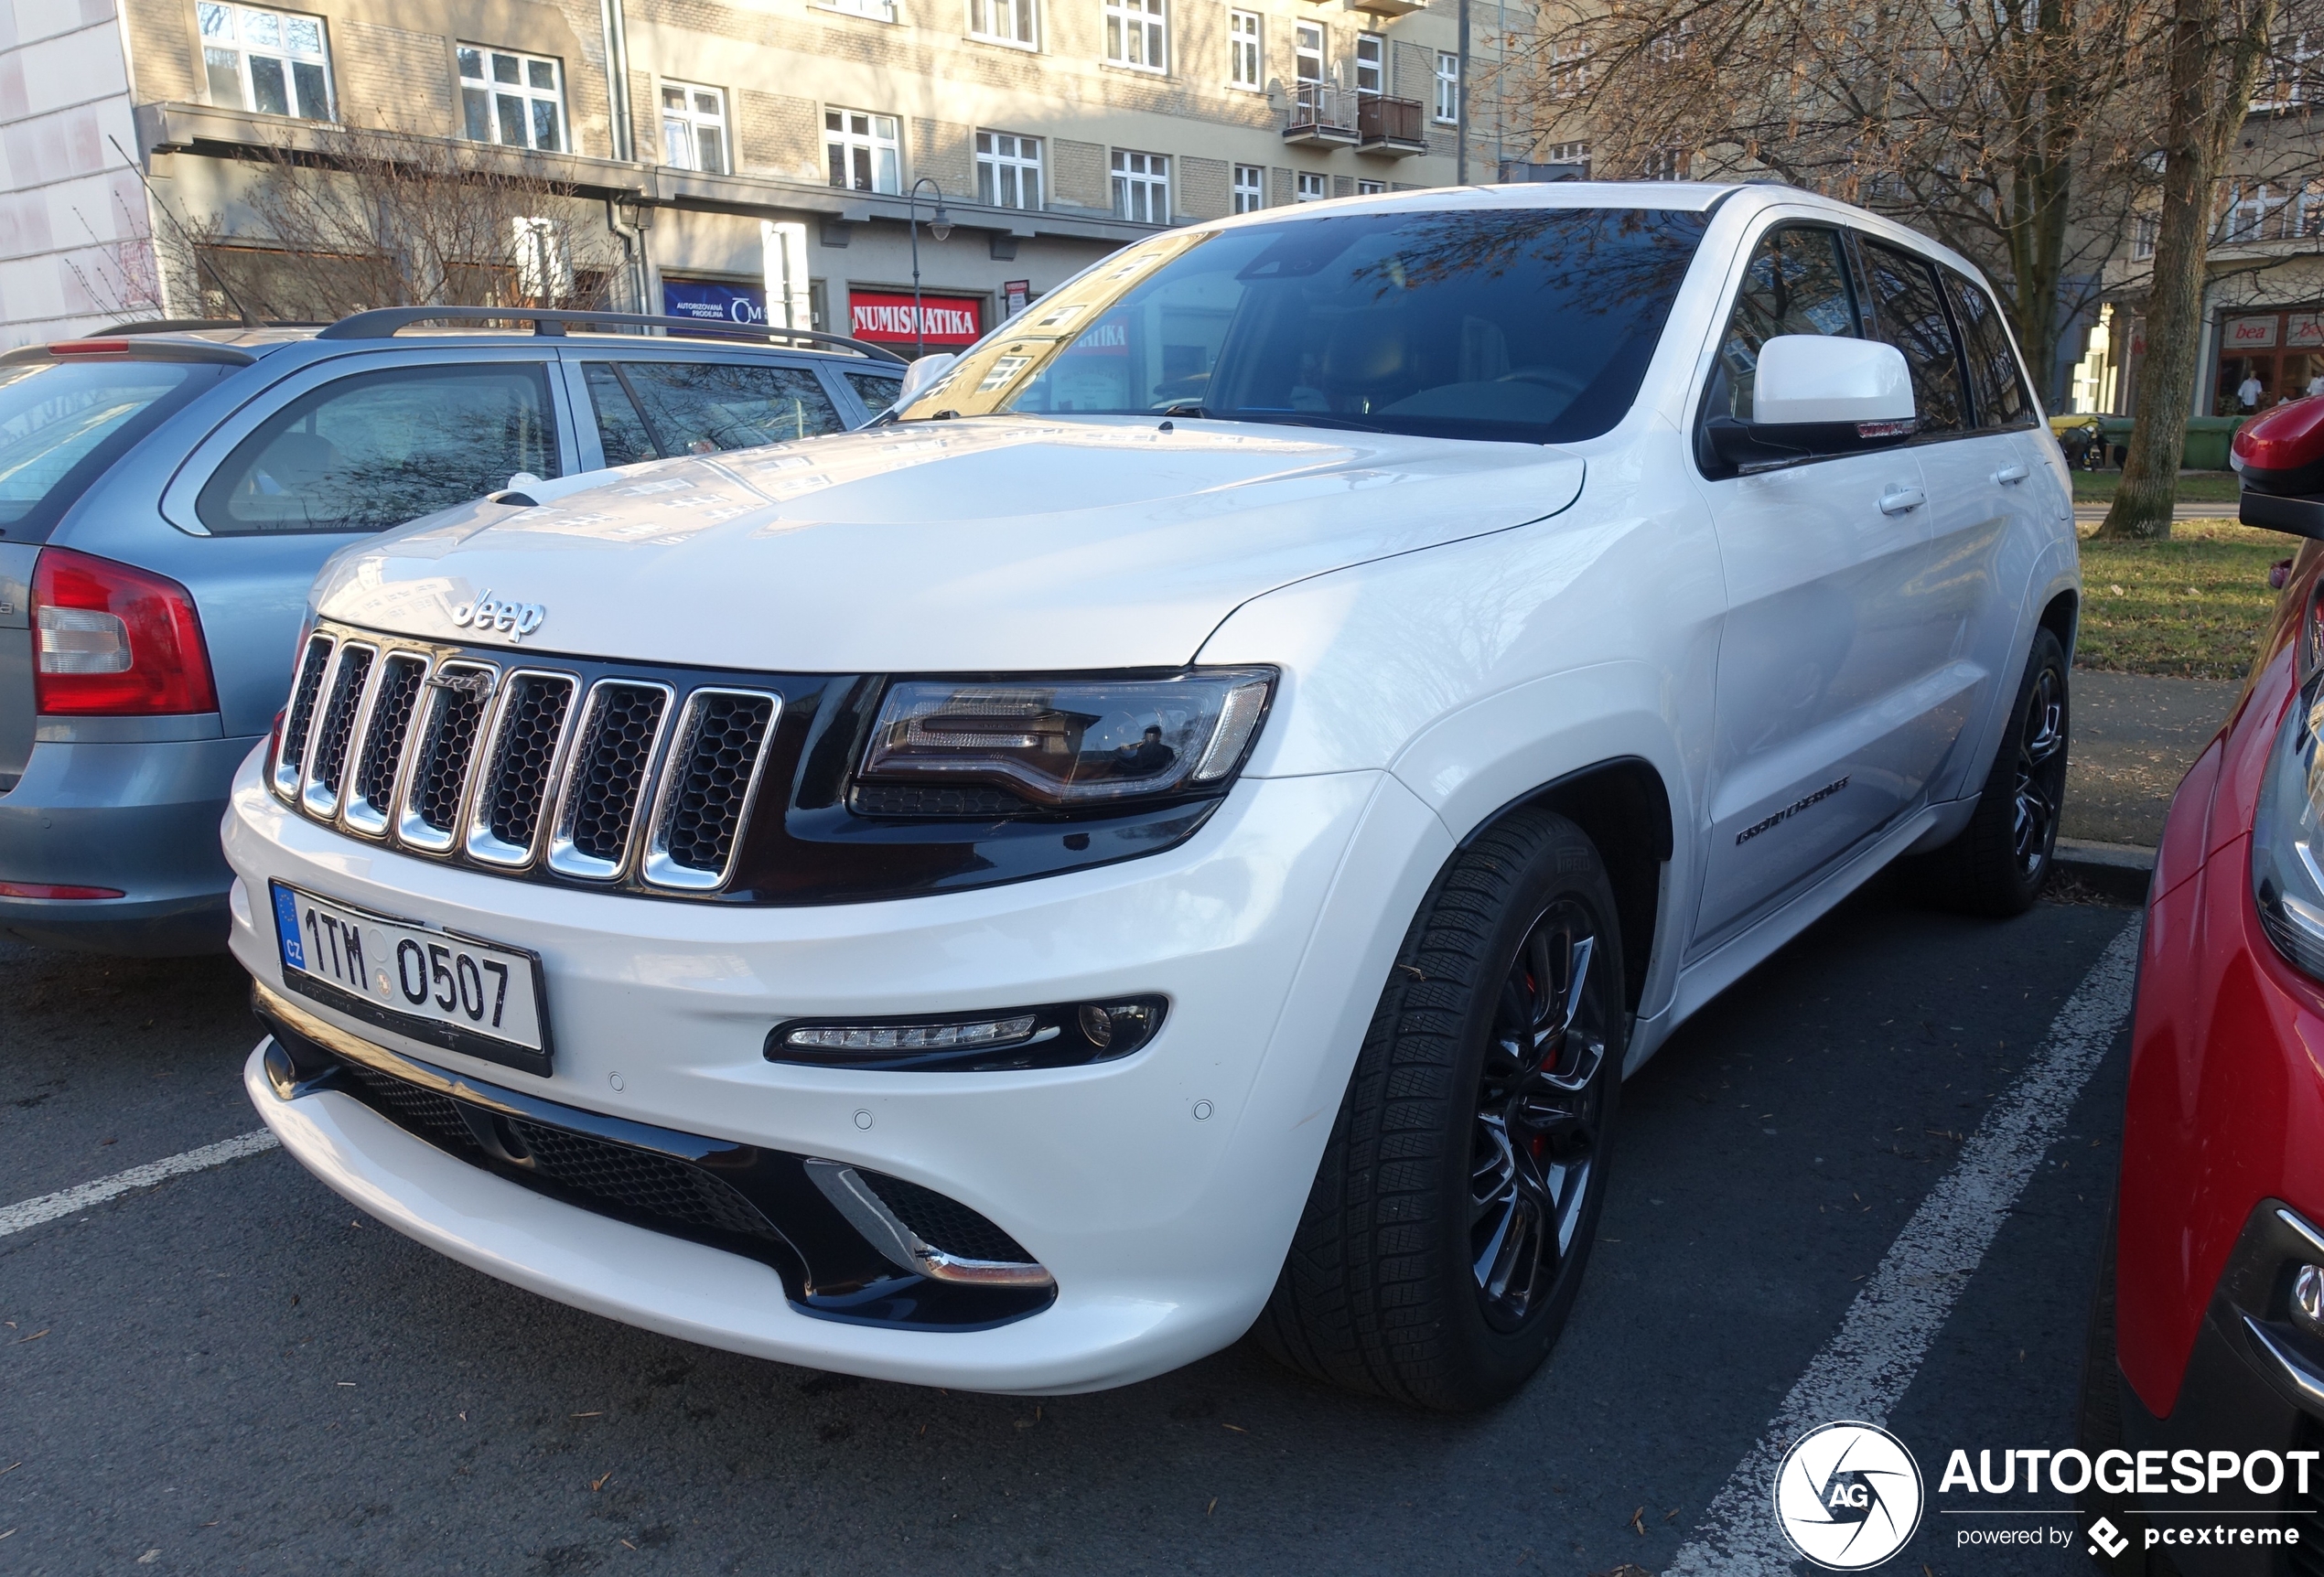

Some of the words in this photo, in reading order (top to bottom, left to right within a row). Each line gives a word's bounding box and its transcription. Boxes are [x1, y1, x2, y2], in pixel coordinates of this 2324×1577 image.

[854, 306, 975, 335] NUMISMATIKA
[2235, 324, 2266, 339] bea
[452, 588, 545, 643] Jeep
[425, 674, 479, 693] SRT
[286, 939, 303, 961] CZ
[305, 907, 369, 991] 1TM
[396, 938, 509, 1028] 0507
